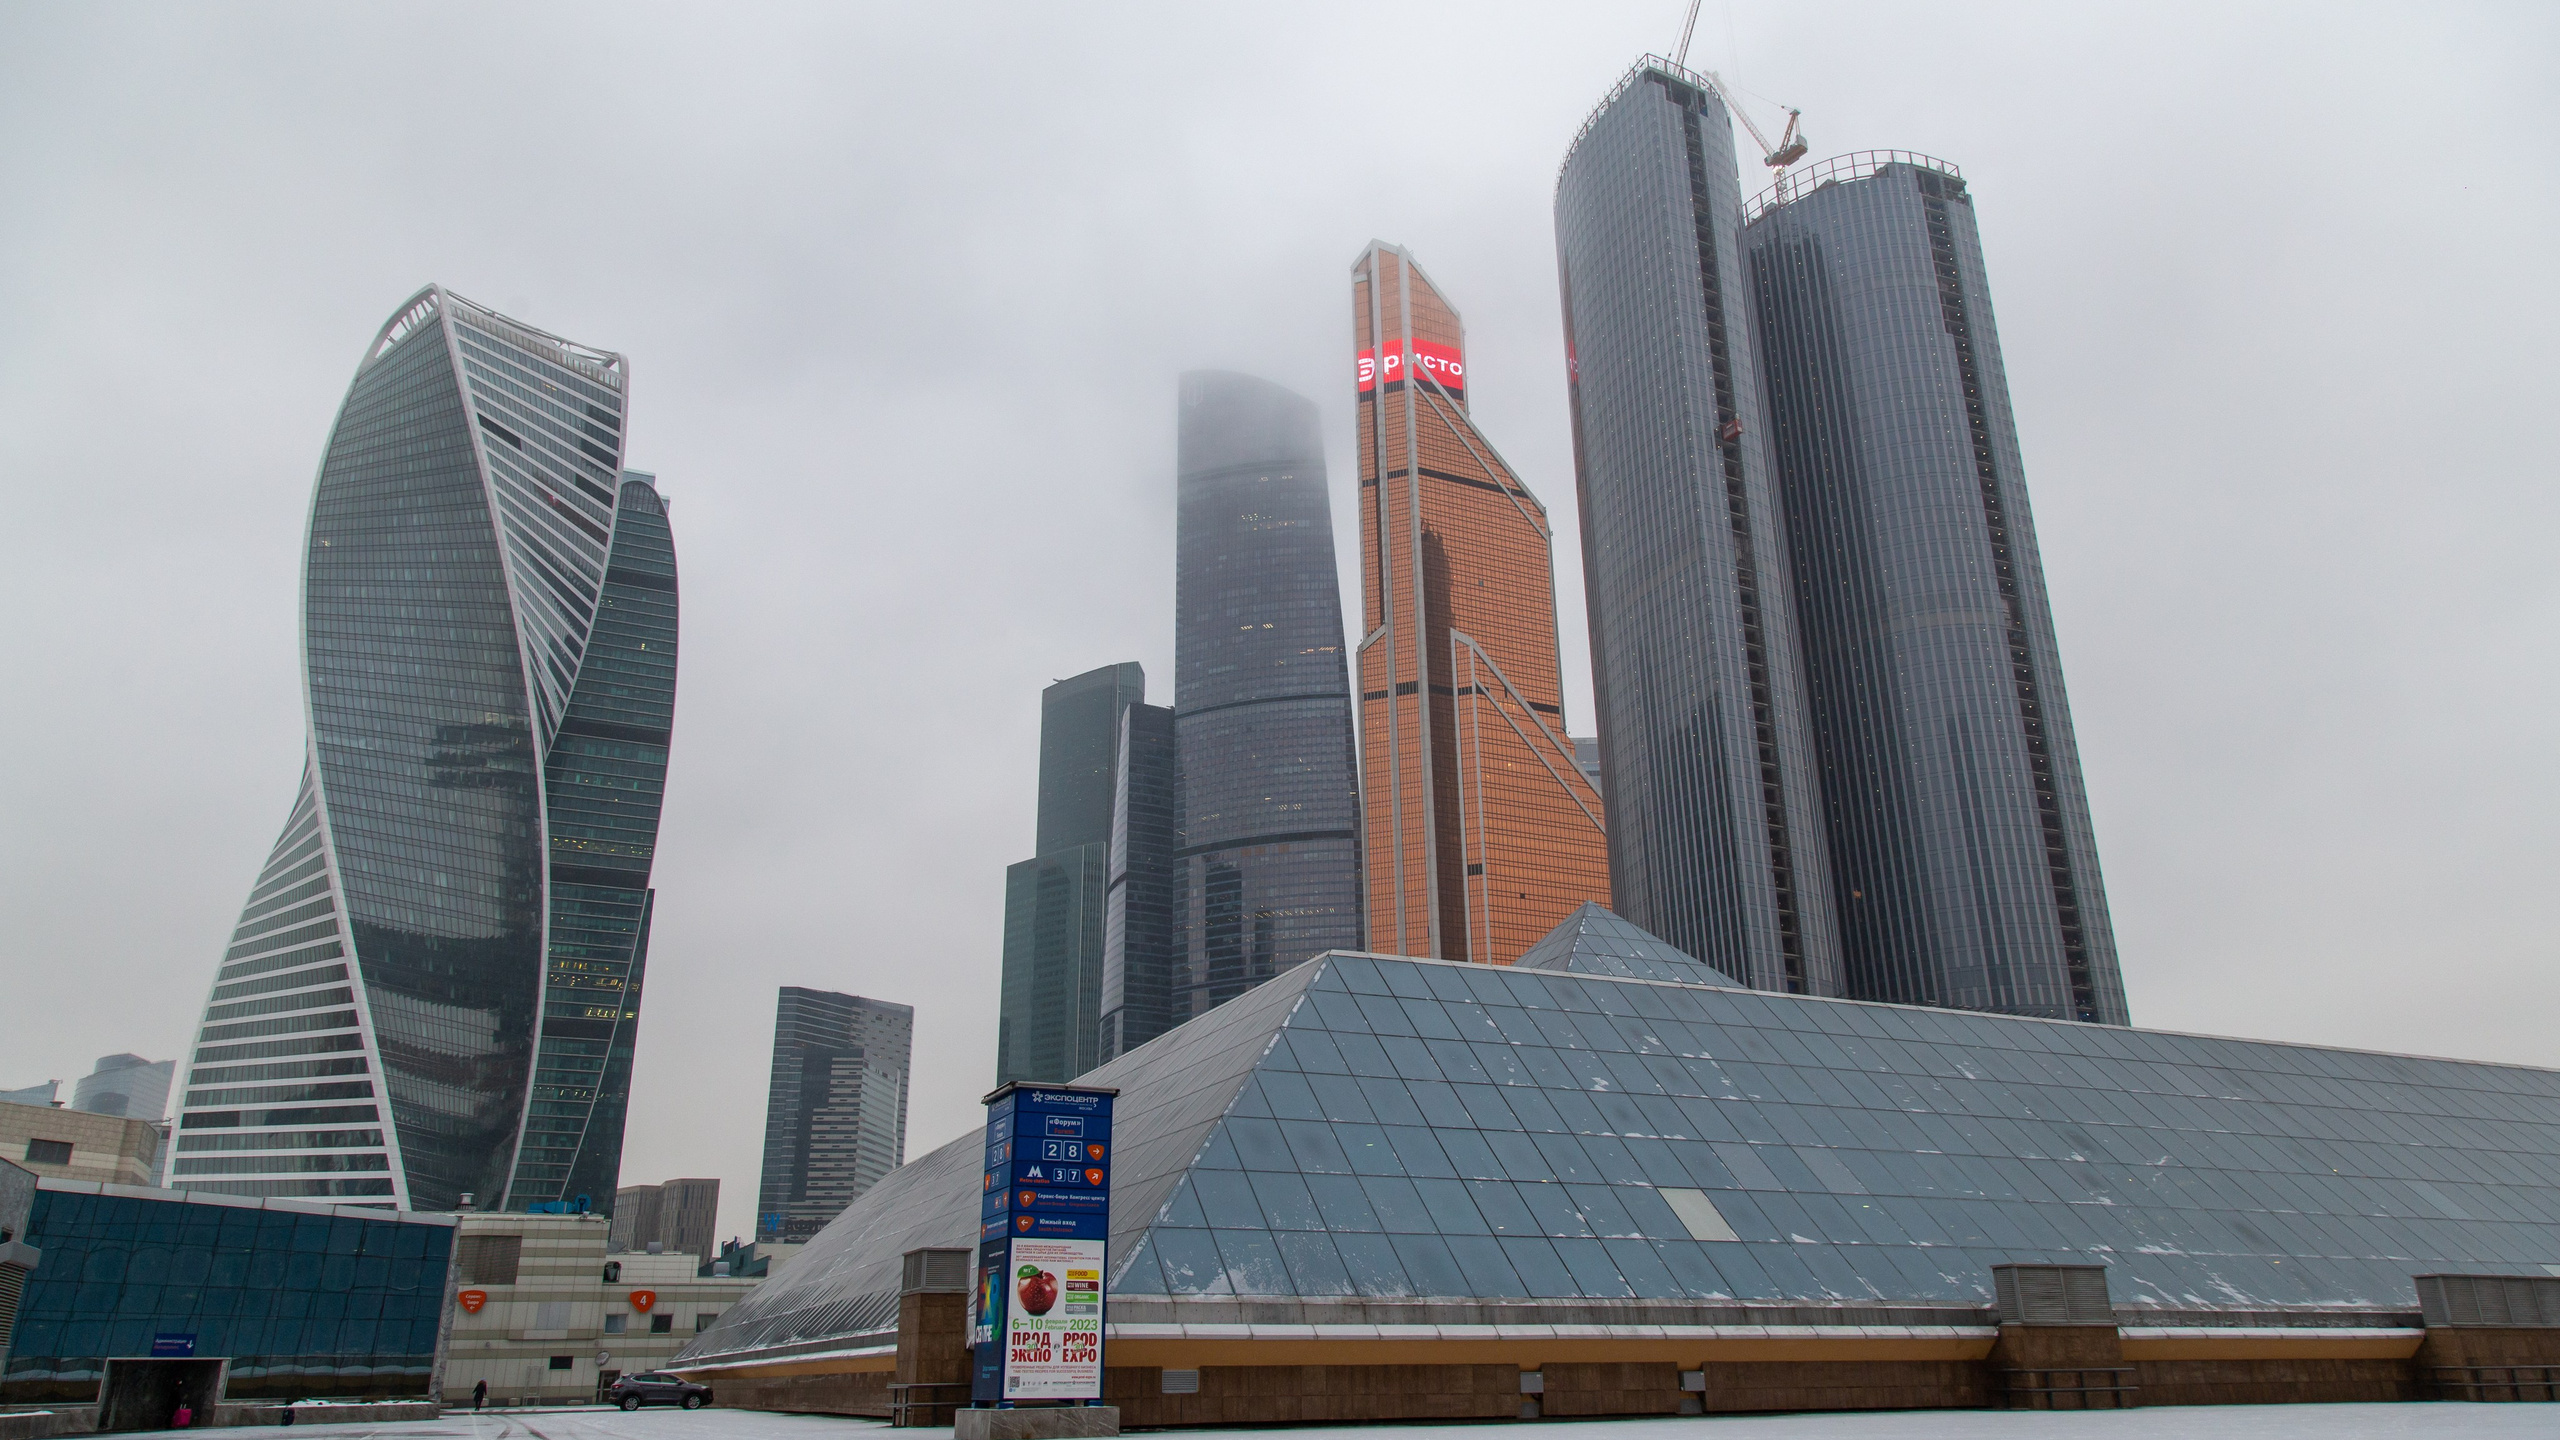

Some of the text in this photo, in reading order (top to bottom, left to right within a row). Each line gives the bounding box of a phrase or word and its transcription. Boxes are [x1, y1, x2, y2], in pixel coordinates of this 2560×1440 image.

[1044, 1094, 1099, 1104] ЭКСПОЦЕНТР
[1047, 1144, 1077, 1158] 2 8
[1056, 1170, 1077, 1180] 3 7
[640, 1295, 647, 1306] 4
[1070, 1318, 1098, 1331] 2023
[1012, 1332, 1051, 1348] ПРОД
[1063, 1332, 1097, 1347] PROD
[1011, 1348, 1051, 1362] ЭКСПО
[1062, 1348, 1097, 1362] EXPO
